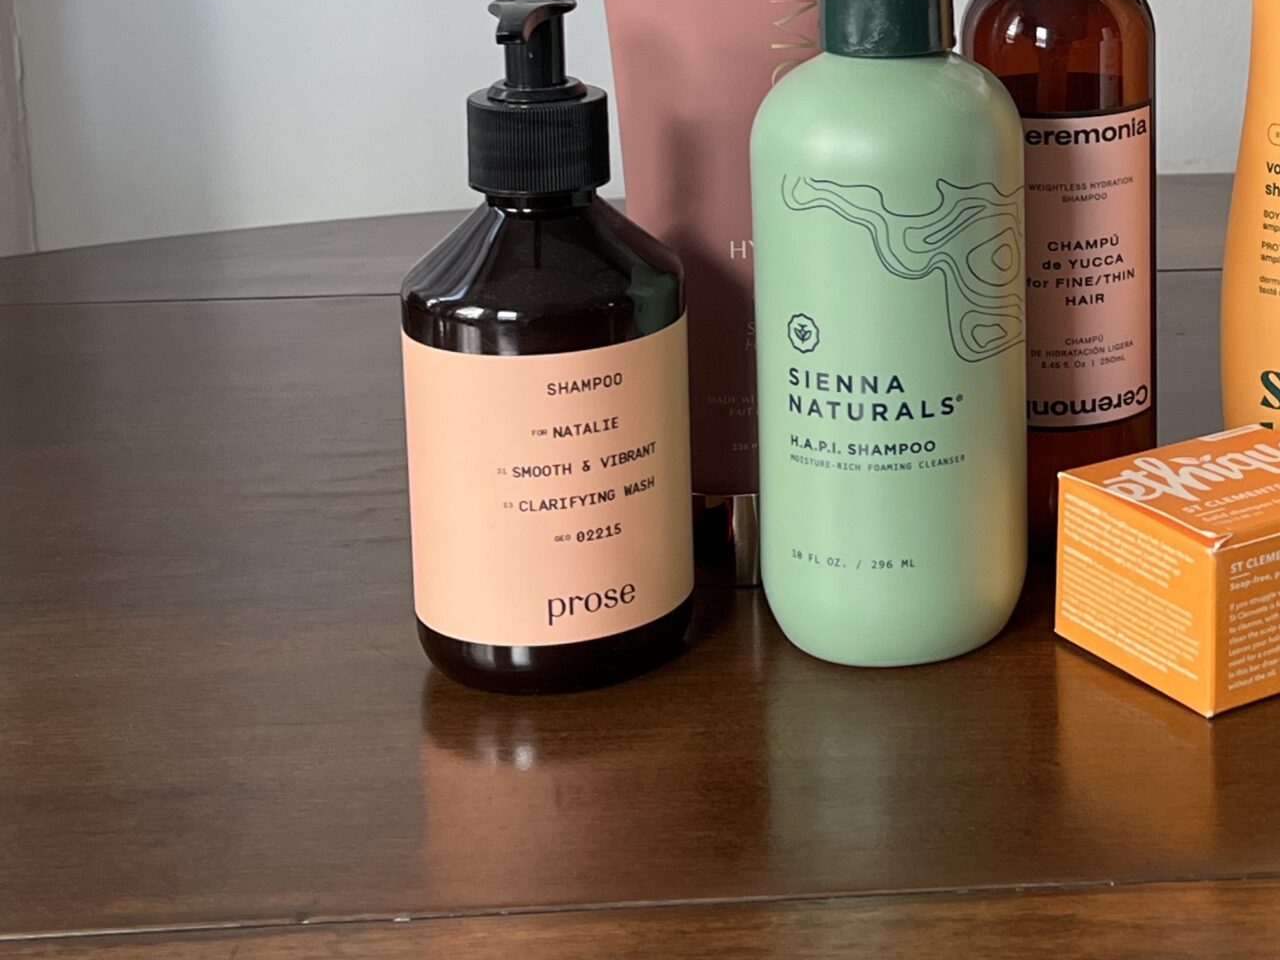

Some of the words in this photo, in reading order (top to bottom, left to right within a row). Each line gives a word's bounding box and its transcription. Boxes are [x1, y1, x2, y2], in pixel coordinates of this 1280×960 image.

[1025, 117, 1147, 146] eremonia
[1028, 183, 1087, 192] WEIGHTLESS
[1090, 176, 1134, 189] HYDRATION
[1062, 192, 1108, 203] SHAMPOO
[1263, 210, 1280, 220] SOY
[1047, 233, 1120, 252] CHAMPÚ
[1042, 260, 1062, 270] de
[1068, 253, 1124, 269] YUCCA
[1026, 277, 1050, 288] for
[1055, 268, 1136, 288] FINE/THIN
[1065, 293, 1105, 307] HAIR
[1108, 340, 1134, 352] LIGERA
[547, 372, 623, 396] SHAMPOO
[788, 367, 906, 394] SIENNA
[789, 393, 956, 422] NATURALS
[1027, 384, 1148, 419] Ceremoni
[553, 416, 619, 439] NATALIE
[790, 434, 842, 454] H.A.P.I.
[847, 440, 936, 456] SHAMPOO
[512, 463, 572, 478] SMOOTH
[582, 460, 591, 472] &
[600, 441, 657, 469] VIBRANT
[790, 454, 861, 471] MOISTURE-RICH
[867, 462, 912, 472] FOAMING
[918, 454, 966, 469] CLEANSER
[519, 489, 616, 512] CLARIFYING
[623, 476, 655, 497] WASH
[1182, 504, 1202, 513] ST
[576, 522, 622, 543] 02215
[808, 553, 820, 565] FL
[827, 557, 846, 568] OZ.
[871, 560, 894, 569] 296
[901, 559, 916, 568] ML
[1230, 560, 1243, 574] ST
[547, 582, 636, 626] prose
